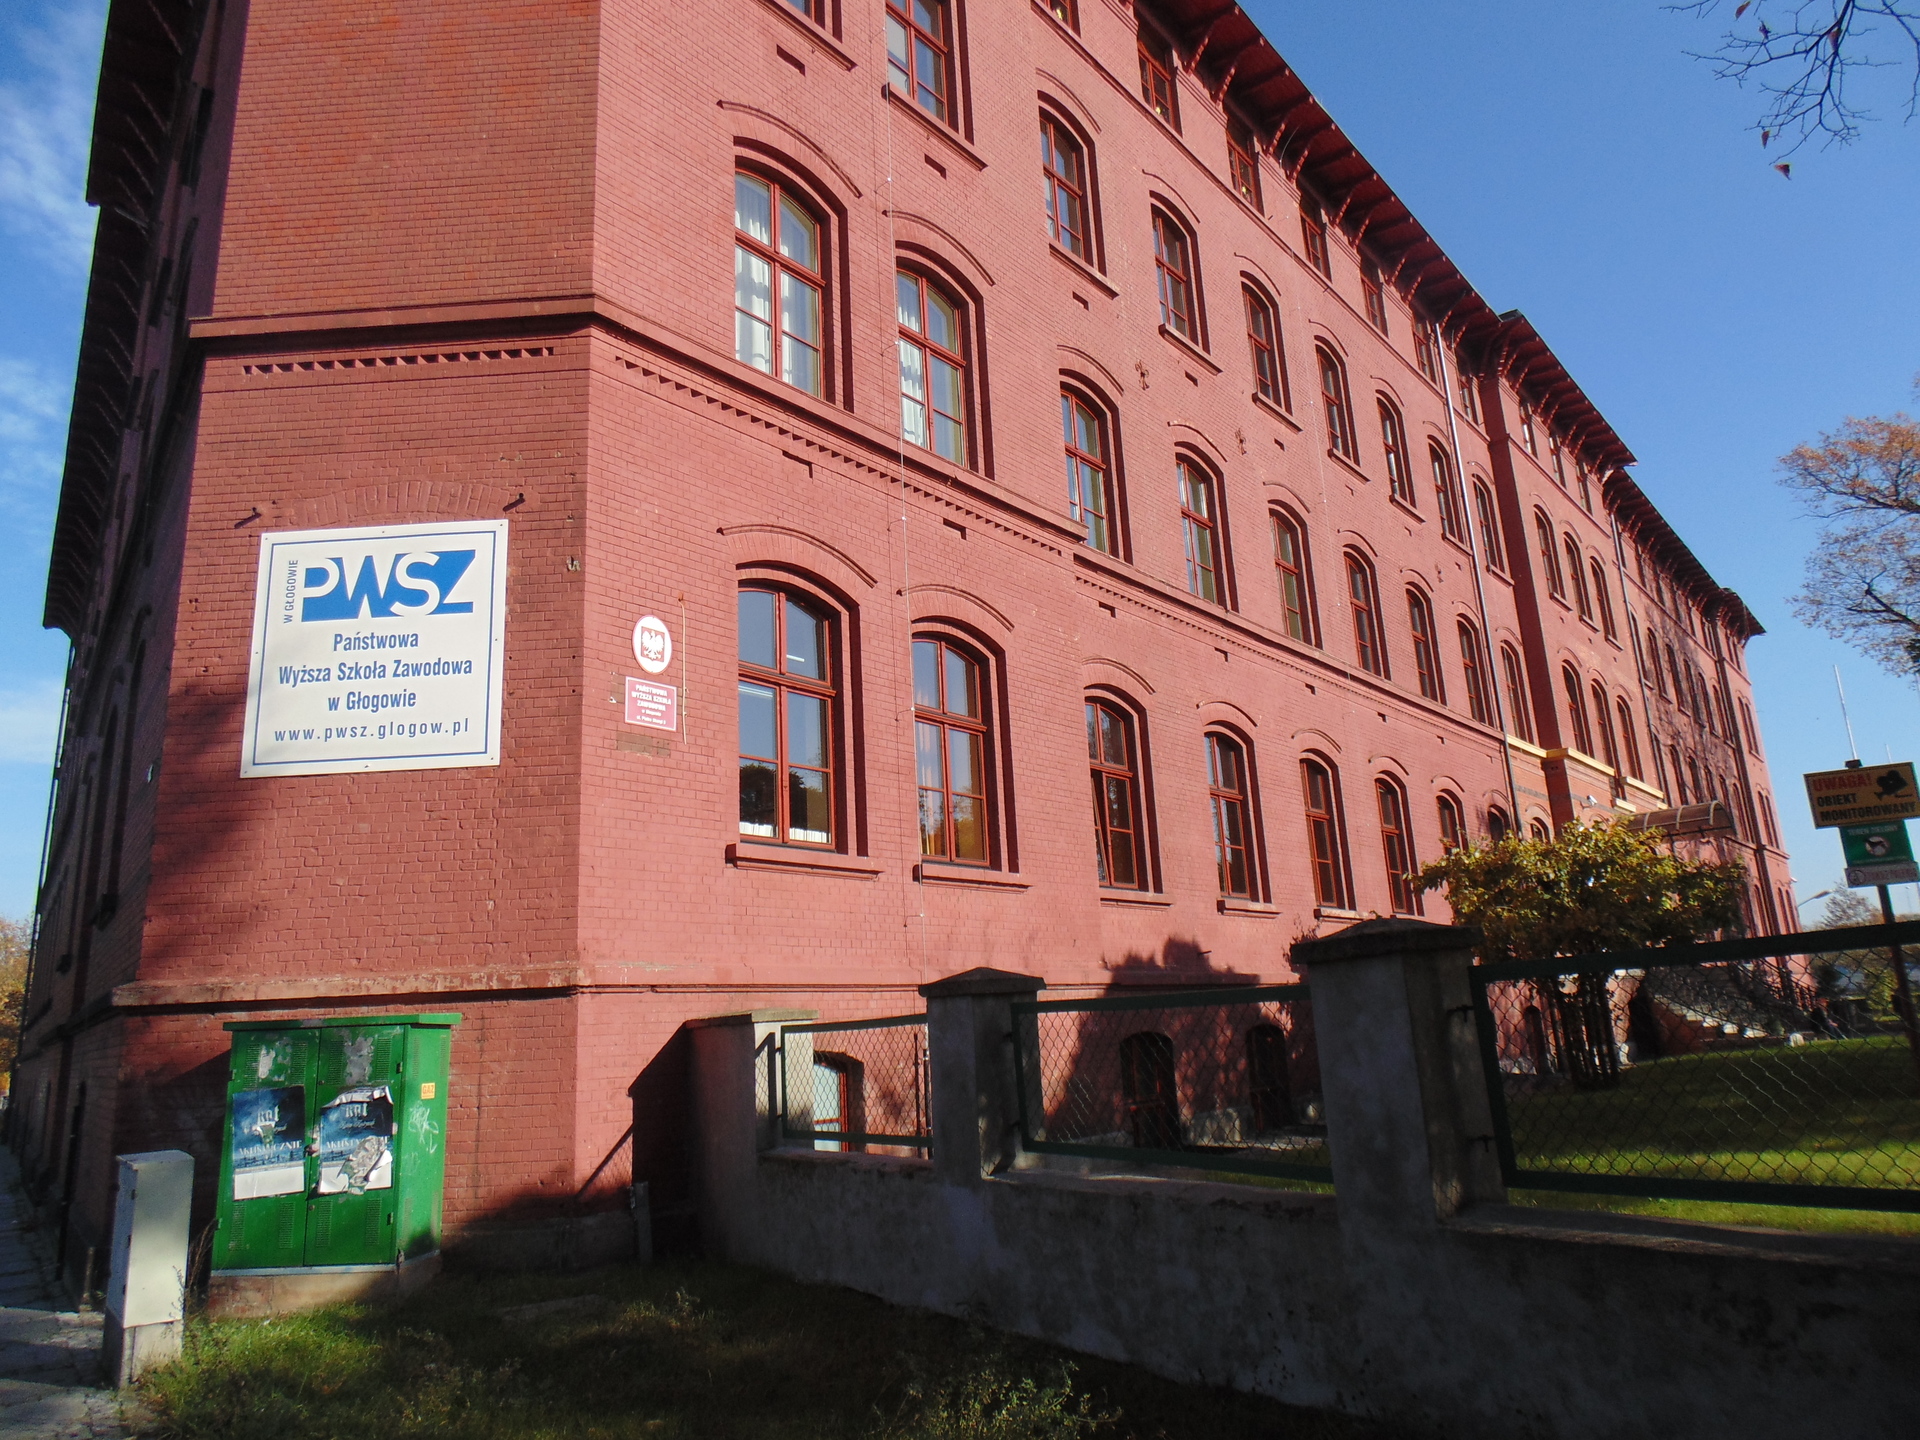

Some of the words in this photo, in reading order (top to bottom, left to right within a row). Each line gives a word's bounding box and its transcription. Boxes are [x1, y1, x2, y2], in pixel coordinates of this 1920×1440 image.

[284, 559, 298, 612] GŁOGOWIE
[301, 549, 476, 622] PWSZ
[283, 613, 294, 624] W
[333, 632, 419, 652] Państwowa
[279, 665, 331, 688] Wyższa
[337, 661, 387, 681] Szkoła
[392, 658, 473, 678] Zawodowa
[328, 697, 340, 711] w
[346, 689, 417, 713] Głogowie
[274, 718, 469, 742] www.pwsz.glogow.pl
[1812, 774, 1873, 791] UWAGA!
[1817, 793, 1858, 807] OBIEKT
[1820, 802, 1917, 821] MONITOROWANY
